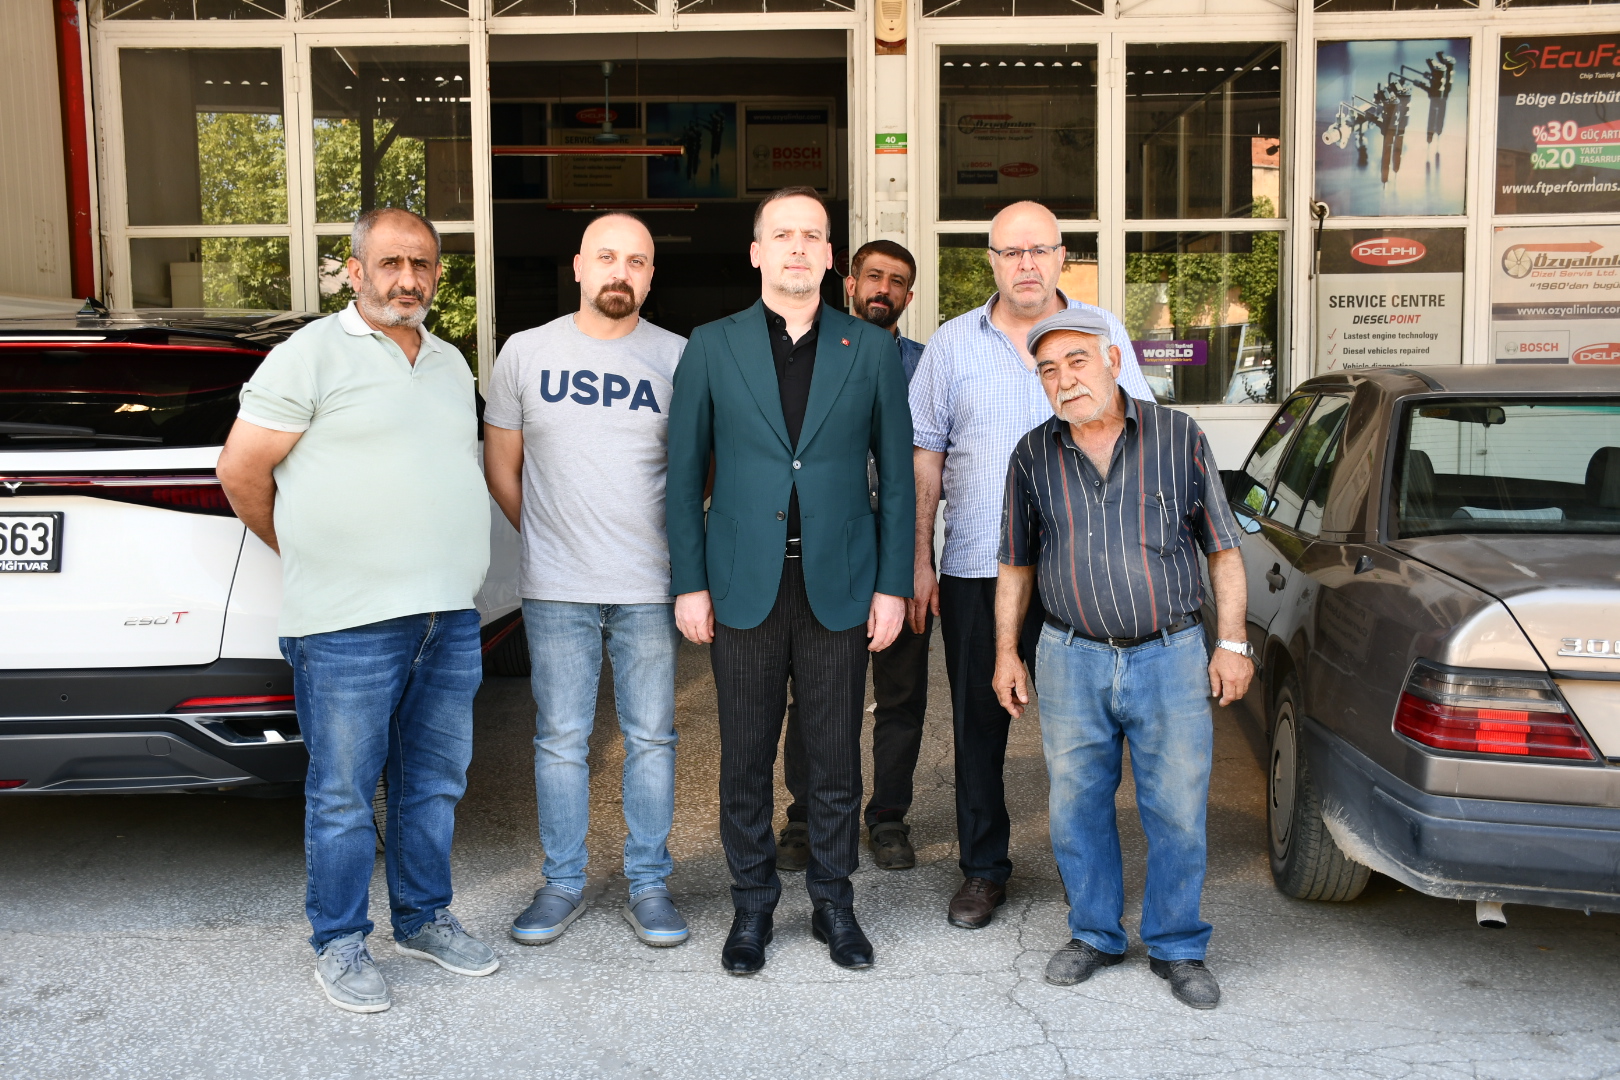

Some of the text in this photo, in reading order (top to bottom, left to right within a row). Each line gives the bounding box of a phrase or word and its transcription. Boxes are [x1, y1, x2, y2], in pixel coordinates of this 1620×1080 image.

[1579, 72, 1593, 80] Chip
[1594, 72, 1615, 80] Tuning
[1515, 90, 1620, 107] Bölge Distribüt
[1532, 121, 1578, 142] %30
[1580, 128, 1600, 142] GÜÇ
[885, 136, 896, 144] 40
[772, 147, 821, 159] BOSCH
[1580, 146, 1603, 154] YAKIT
[1531, 148, 1576, 169] %20
[1358, 246, 1417, 256] DELPHI
[1533, 253, 1620, 270] Özyalınl
[1596, 269, 1617, 277] Ltd.
[1328, 294, 1446, 308] SERVICE CENTRE
[1352, 314, 1422, 325] DIESELPOINT
[1343, 331, 1439, 341] Lastest engine technology
[1143, 349, 1193, 357] WORLD
[1342, 346, 1430, 356] Diesel vehicles repaired
[1519, 342, 1559, 353] BOSCH
[1579, 351, 1620, 361] DELP
[540, 369, 661, 413] USPA
[0, 560, 49, 571] İĞİTVAR
[1558, 638, 1620, 655] 30
